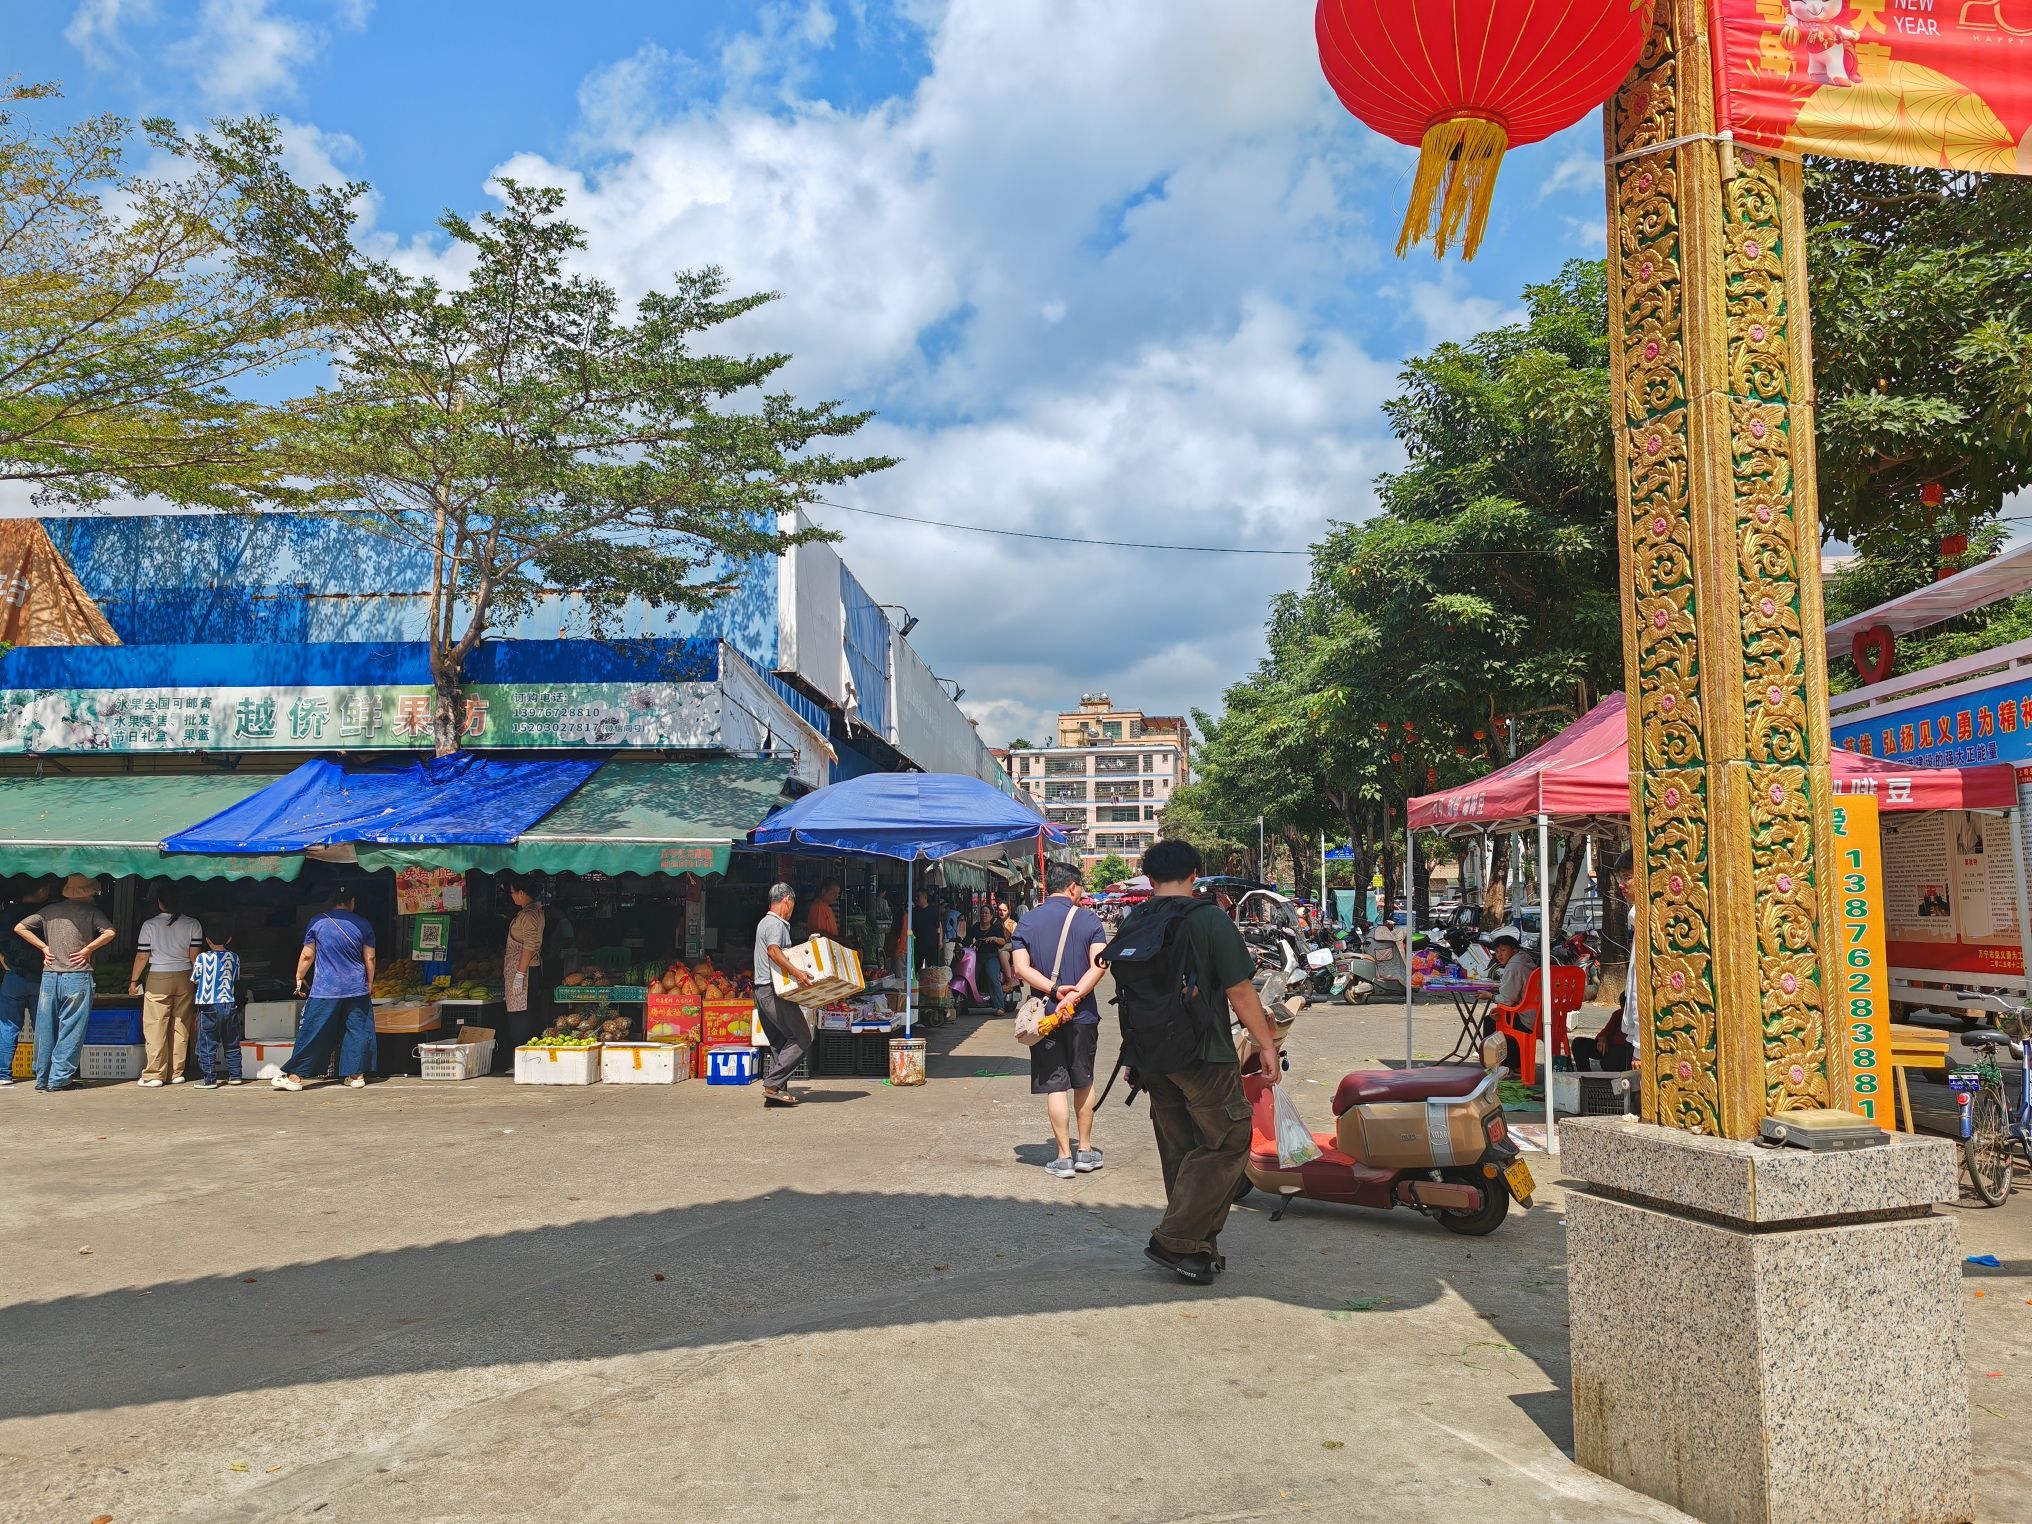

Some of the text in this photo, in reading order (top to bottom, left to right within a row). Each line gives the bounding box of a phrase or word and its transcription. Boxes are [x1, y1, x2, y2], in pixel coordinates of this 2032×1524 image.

[1893, 15, 1941, 36] YEAR
[1972, 34, 2025, 45] HAPPY
[115, 696, 213, 712] 水果全国可邮寄
[512, 691, 568, 704] 订购电话:
[512, 707, 600, 718] 13976728810
[113, 713, 211, 728] 水果零售、批发
[113, 728, 211, 744] 节日礼盒、果篮
[1843, 848, 1878, 1120] 13876283881
